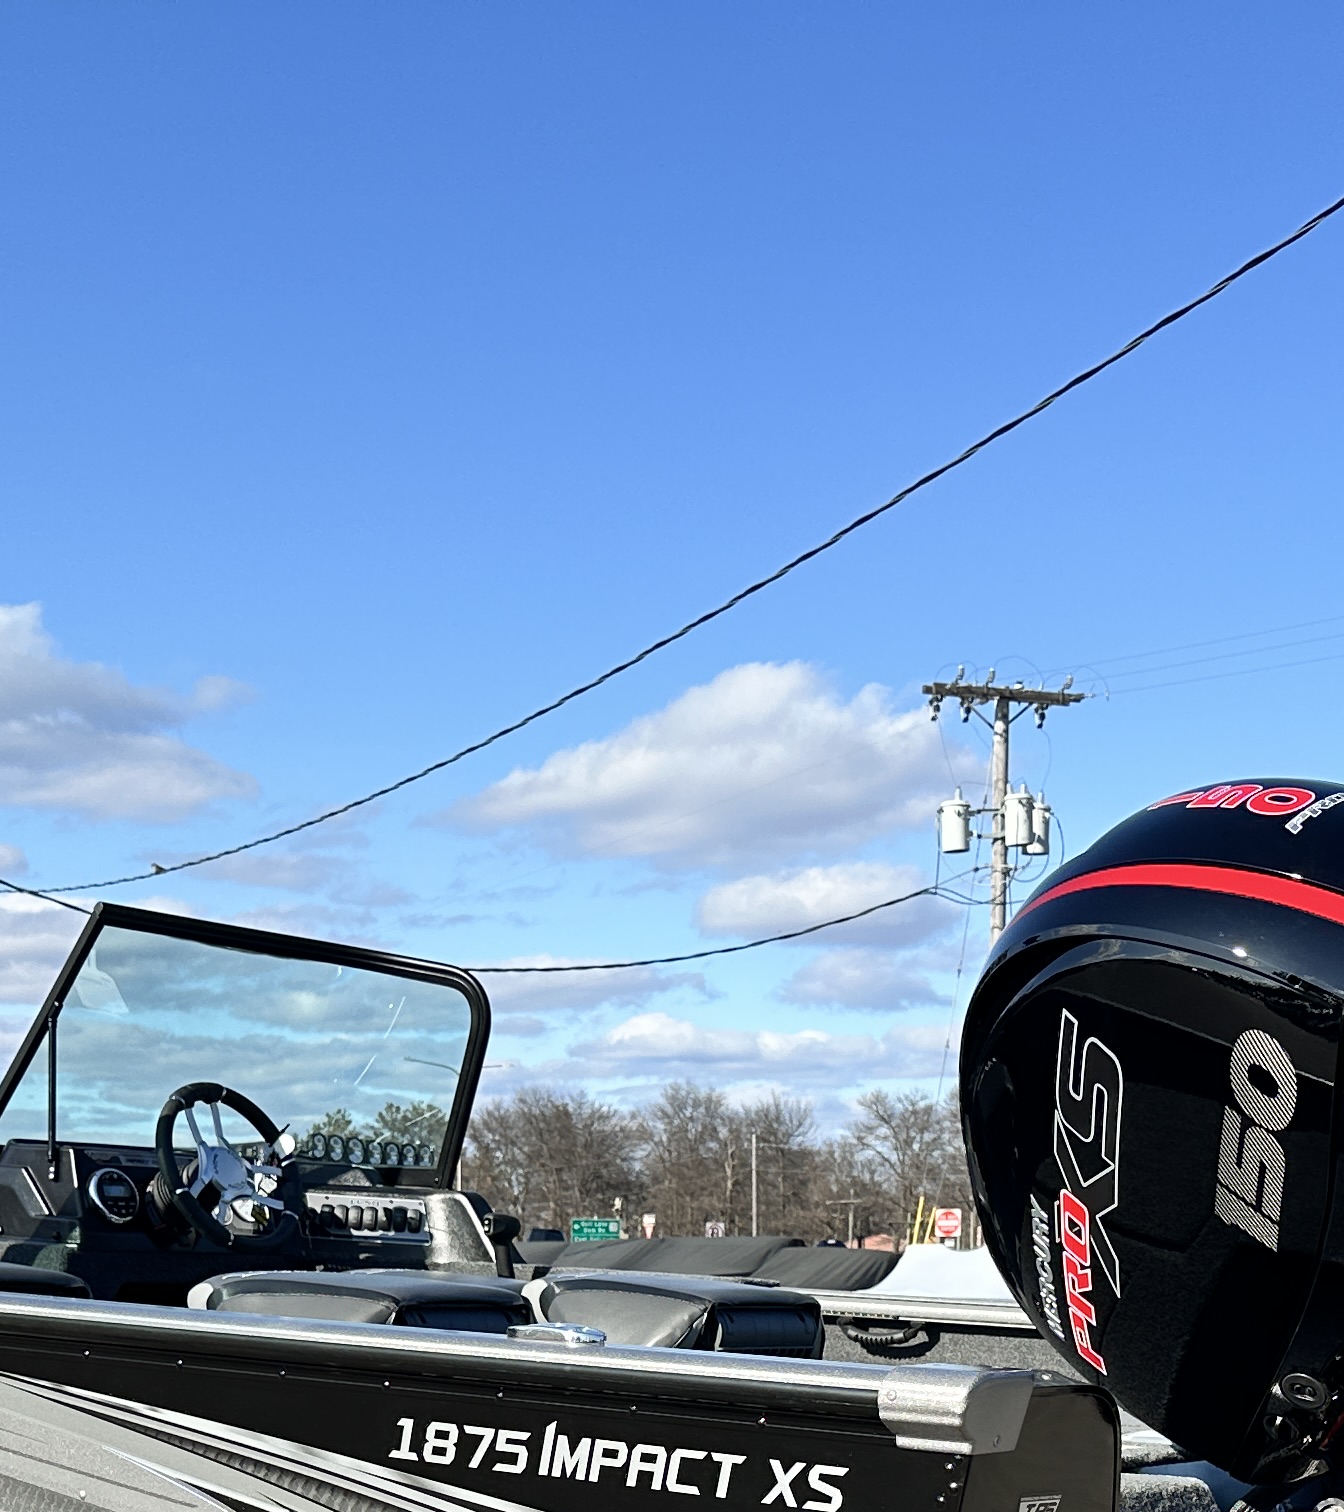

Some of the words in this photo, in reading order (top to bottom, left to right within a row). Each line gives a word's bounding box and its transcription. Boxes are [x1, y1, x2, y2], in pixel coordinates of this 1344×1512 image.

[1054, 1008, 1124, 1299] XS
[1214, 1028, 1299, 1253] 150
[1030, 1193, 1066, 1342] MERCURY
[1060, 1188, 1108, 1376] PRO
[388, 1417, 532, 1475] 1875
[537, 1420, 748, 1499] IMPACT
